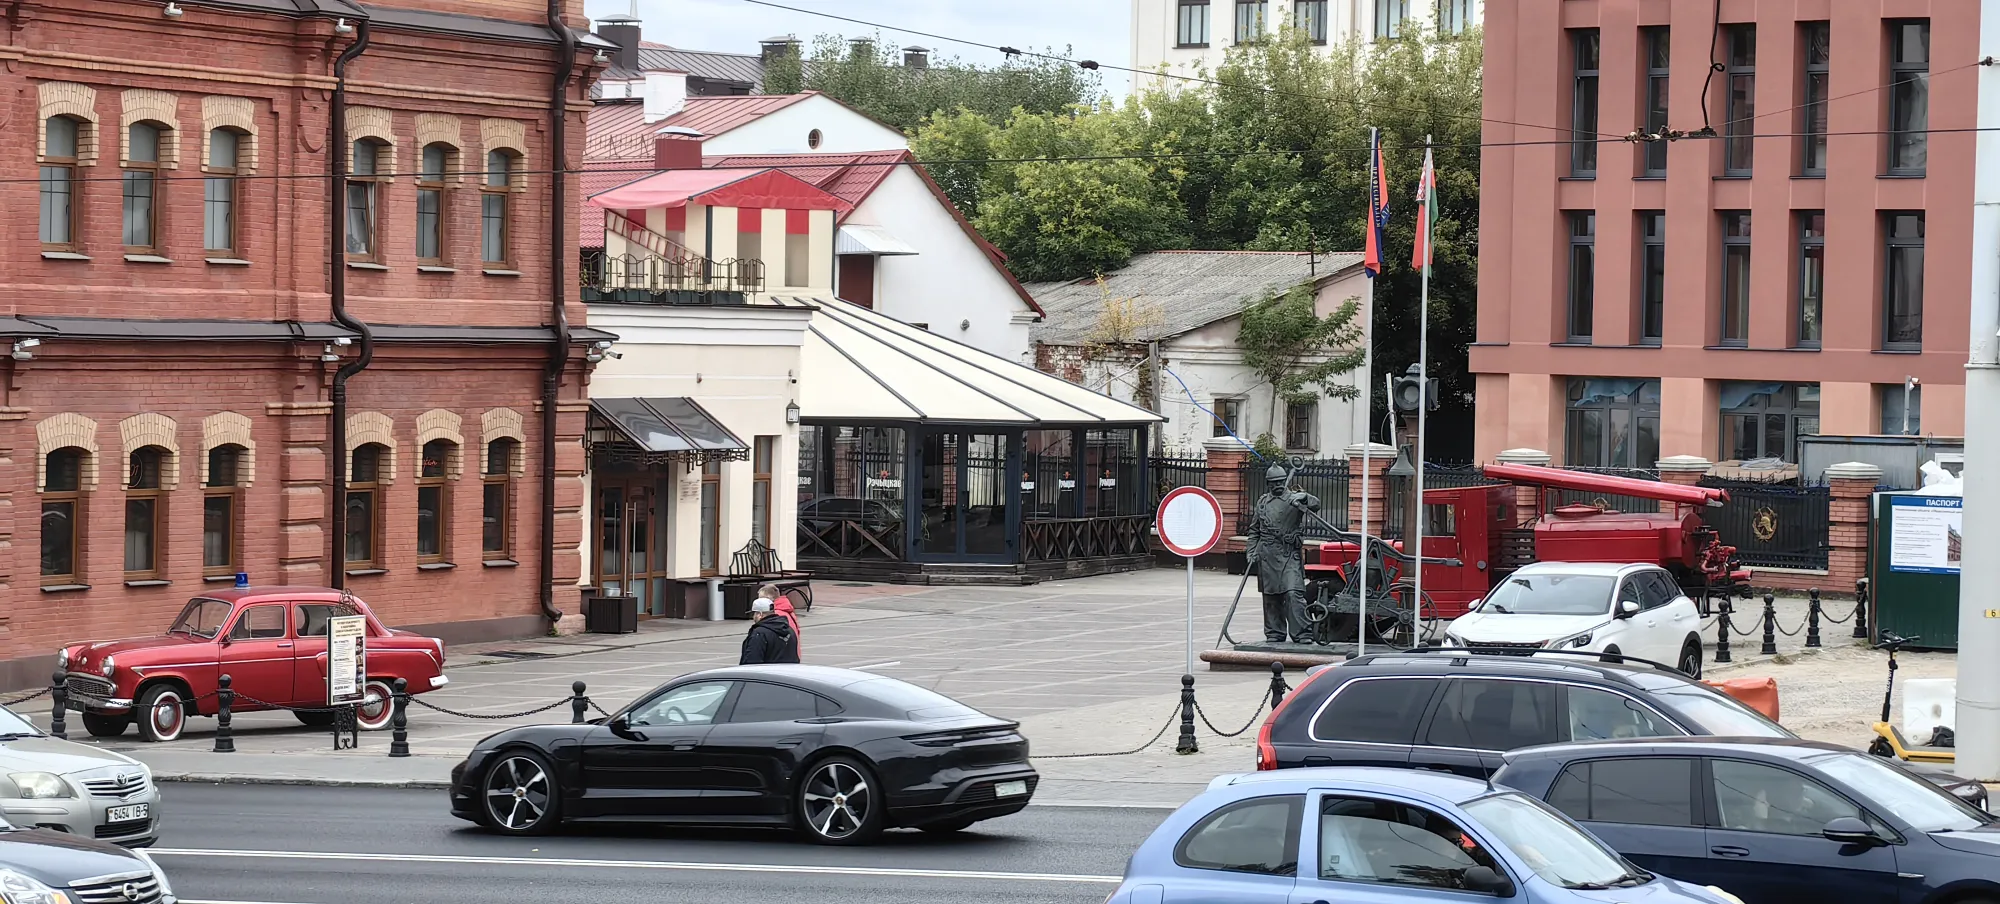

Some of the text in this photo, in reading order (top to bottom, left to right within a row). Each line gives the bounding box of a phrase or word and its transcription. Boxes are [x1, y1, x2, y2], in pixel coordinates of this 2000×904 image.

[1926, 499, 1960, 507] ПАСПОРТ
[1991, 609, 1997, 618] 6
[114, 808, 129, 820] 6454
